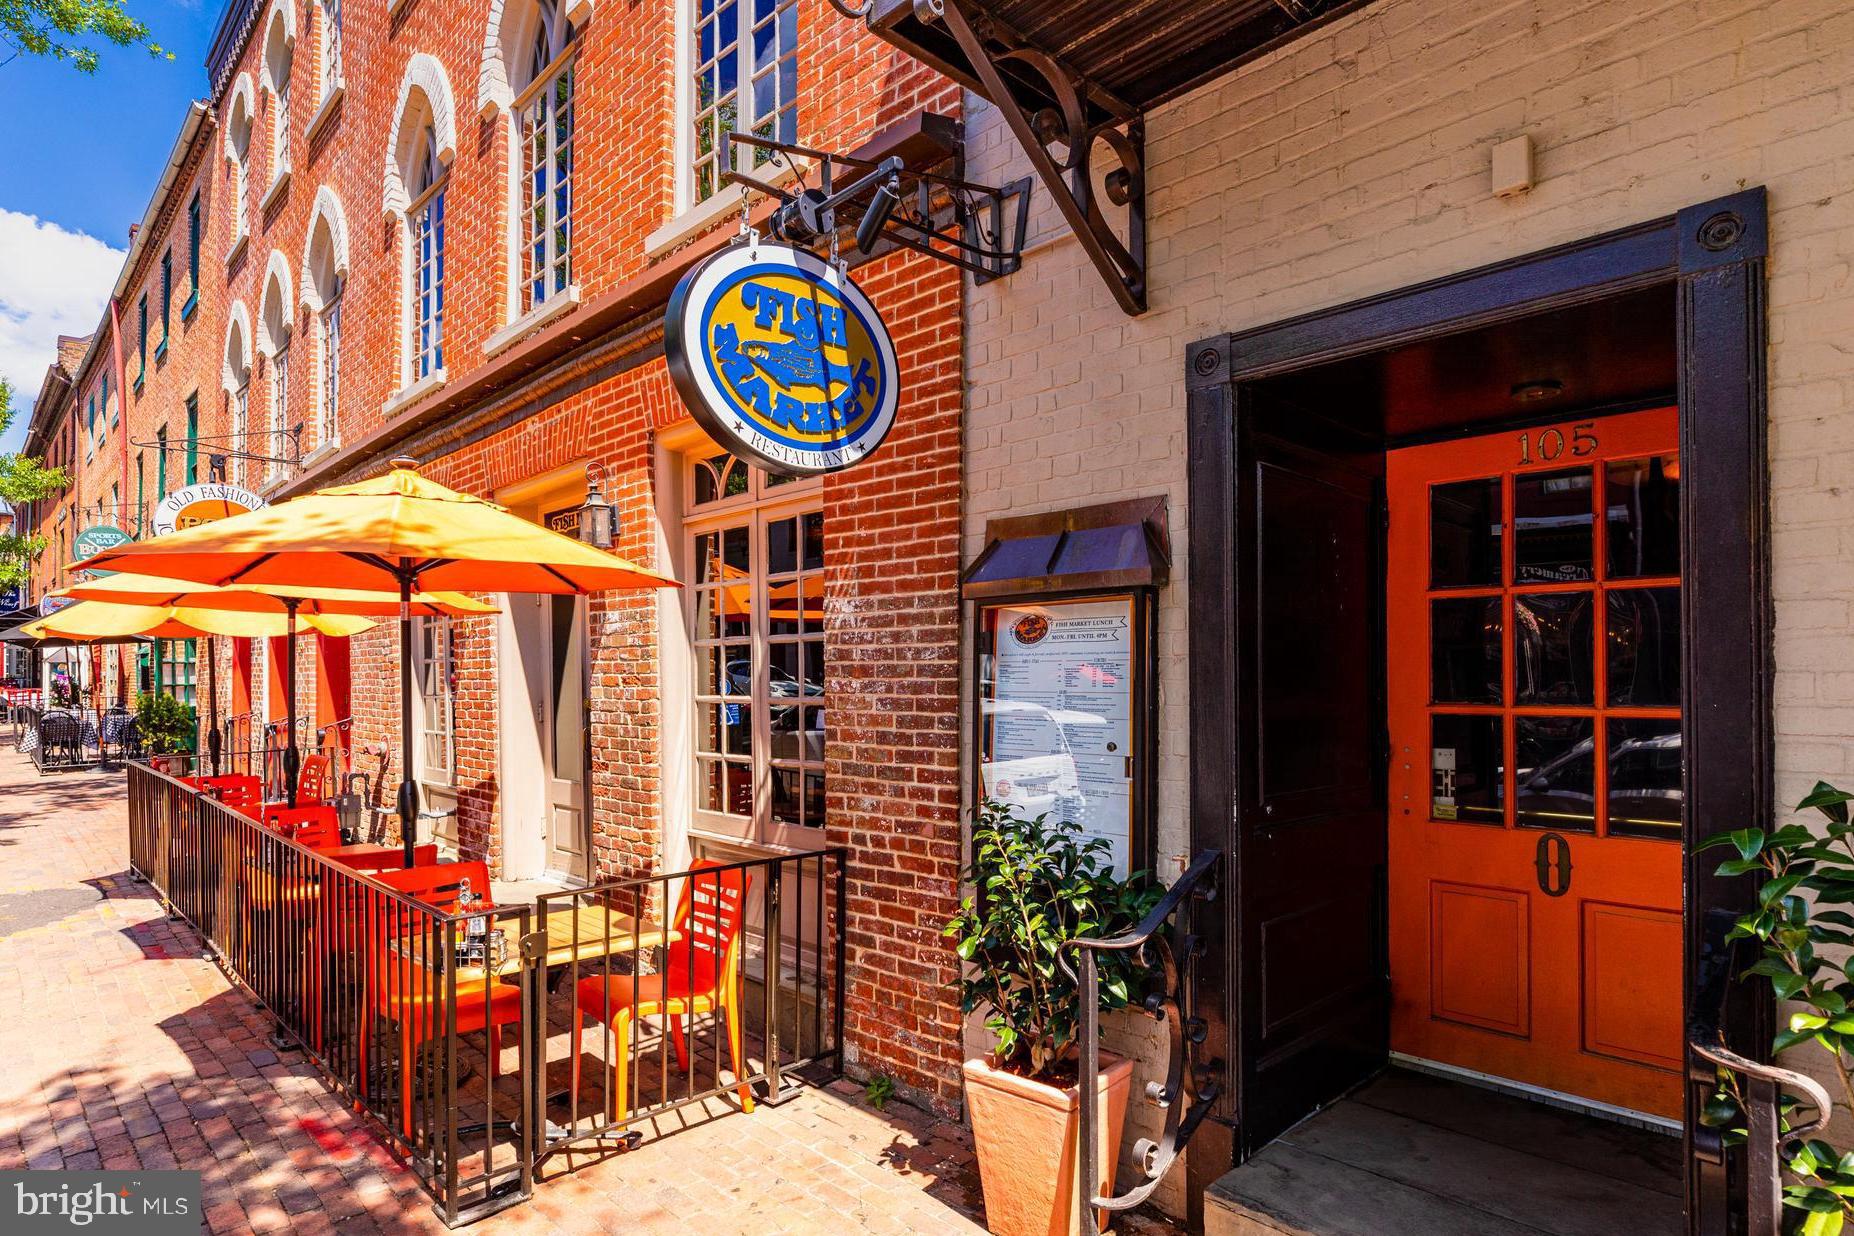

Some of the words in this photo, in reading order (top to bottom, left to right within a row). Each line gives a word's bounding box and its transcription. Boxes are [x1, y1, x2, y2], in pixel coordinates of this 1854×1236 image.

[741, 281, 848, 349] FISH
[713, 322, 877, 436] MARKET
[751, 431, 852, 467] RESTAURANT
[1518, 422, 1598, 465] 105
[167, 490, 194, 512] OLD
[88, 532, 122, 540] SPORTS
[552, 513, 576, 531] FISH
